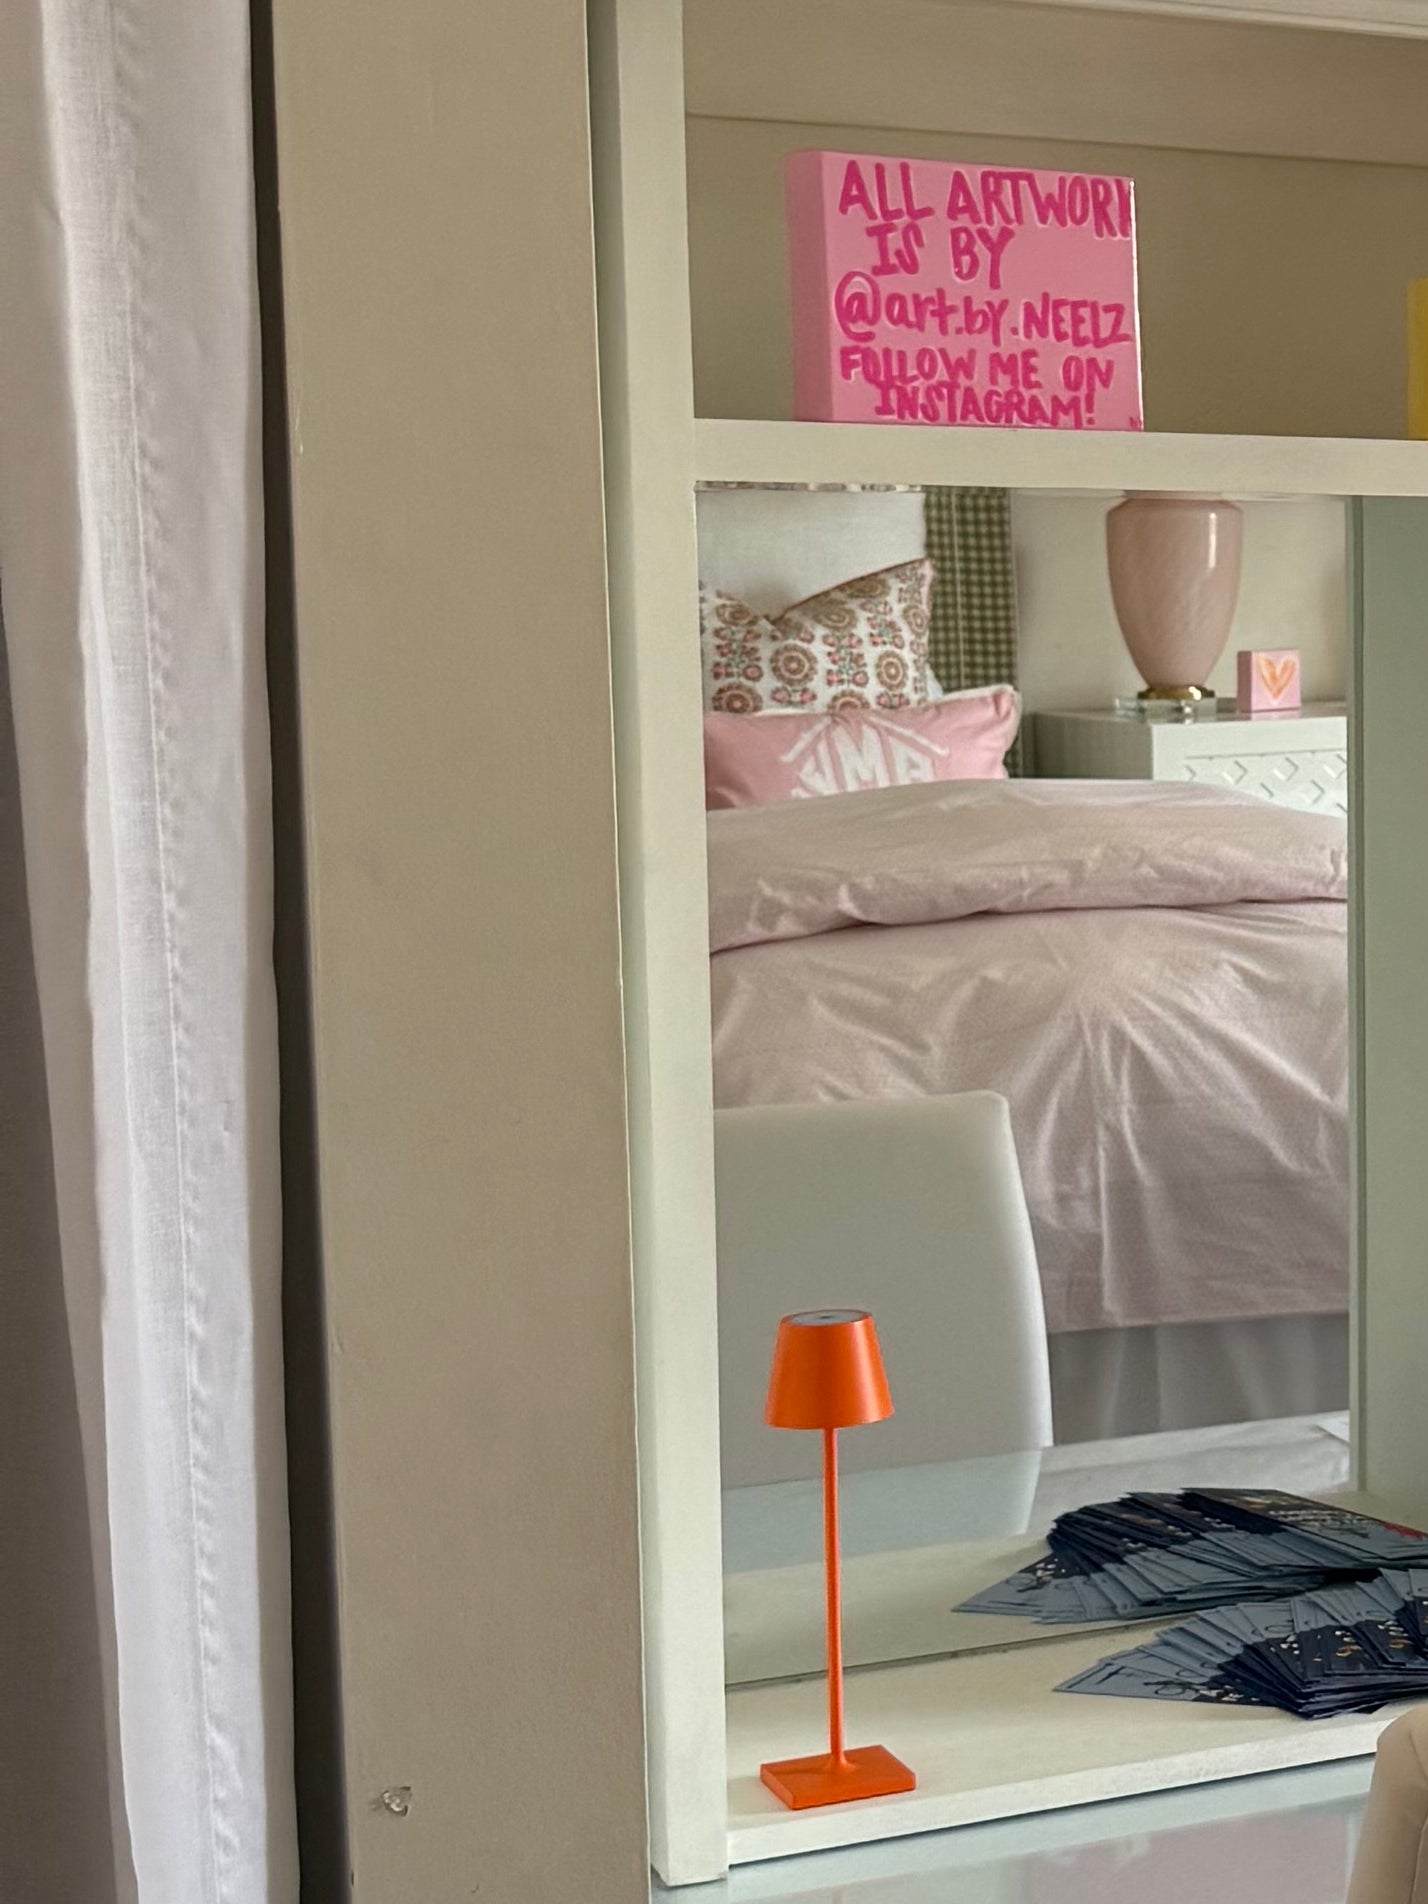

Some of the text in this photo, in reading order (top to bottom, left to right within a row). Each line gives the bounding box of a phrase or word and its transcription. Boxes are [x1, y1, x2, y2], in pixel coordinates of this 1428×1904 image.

[839, 160, 935, 222] ALL
[866, 222, 1014, 290] IS BY
[840, 346, 1114, 392] FOLLOW ME ON
[875, 380, 1095, 429] INSTAGRAM!
